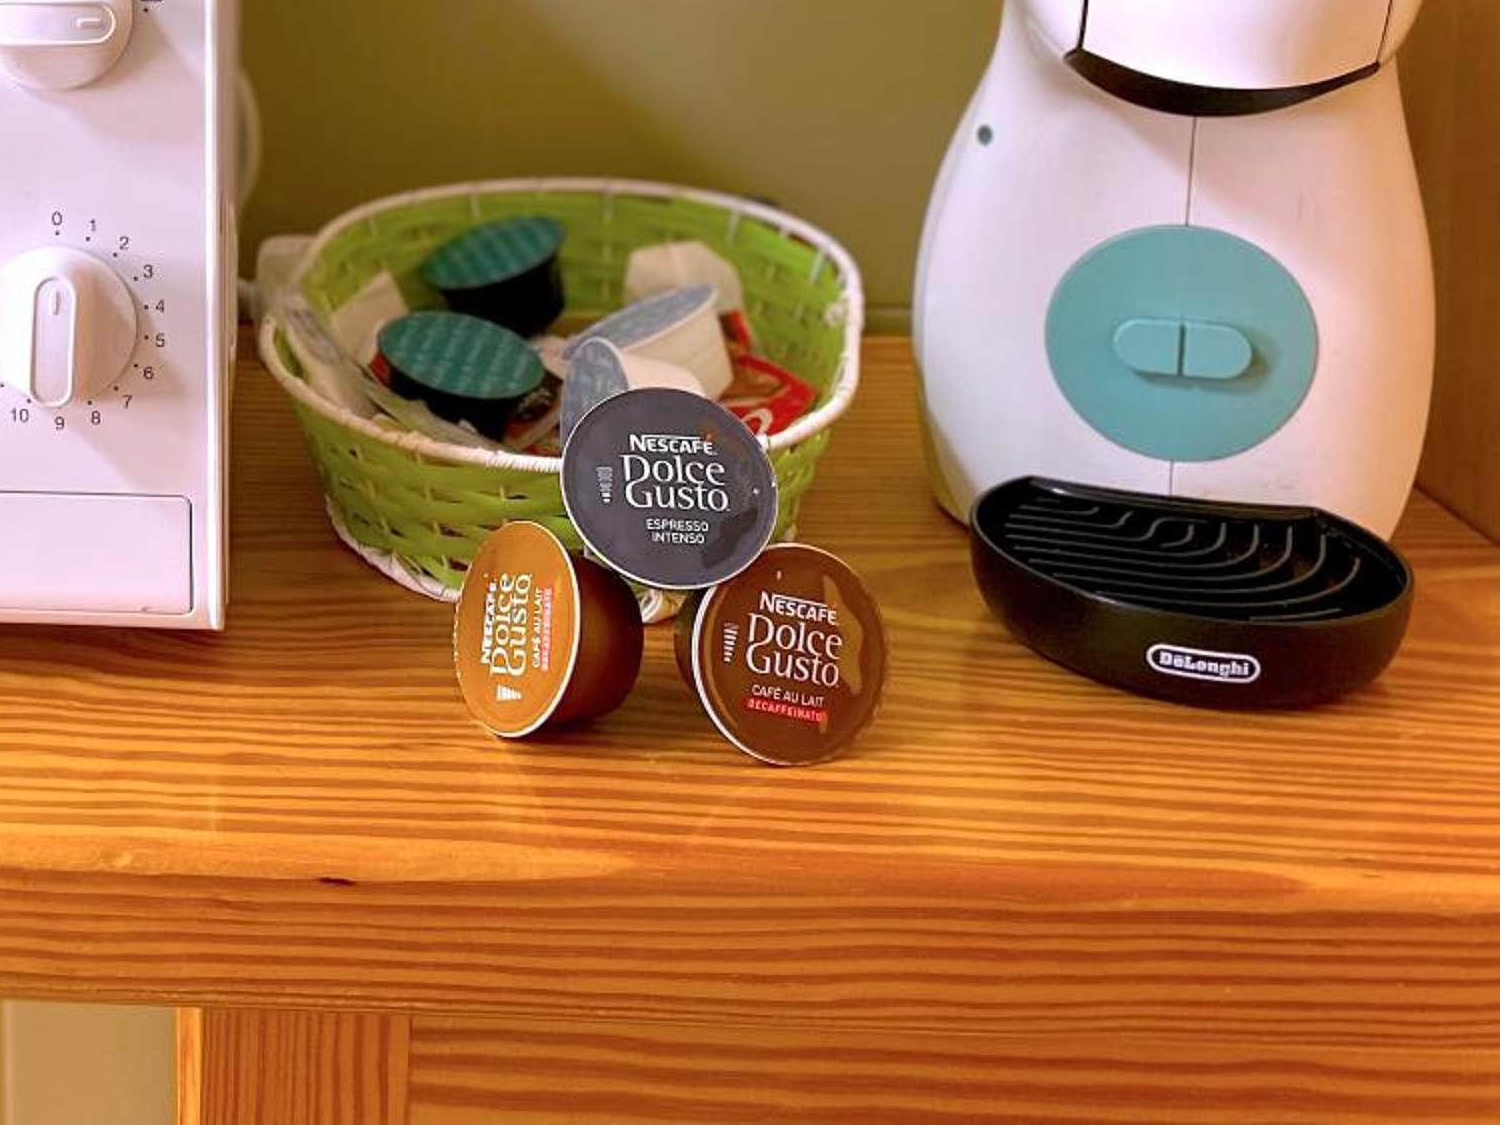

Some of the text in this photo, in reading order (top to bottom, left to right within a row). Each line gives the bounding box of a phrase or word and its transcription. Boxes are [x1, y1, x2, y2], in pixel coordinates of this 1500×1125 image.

[51, 211, 63, 226] 0
[89, 219, 96, 232] 1
[119, 236, 129, 250] 2
[143, 264, 153, 279] 3
[155, 299, 165, 313] 4
[155, 332, 165, 348] 5
[143, 367, 154, 380] 6
[122, 395, 132, 409] 7
[11, 408, 29, 423] 10
[54, 416, 65, 430] 9
[91, 410, 101, 425] 8
[620, 453, 726, 486] Dolce
[625, 480, 729, 512] Gusto
[646, 518, 709, 532] ESPRESSO
[652, 532, 705, 544] INTENSO
[490, 573, 515, 674] Dolce
[507, 575, 531, 676] Gusto
[747, 613, 843, 660] Dolce
[746, 642, 840, 687] Gusto
[1159, 651, 1249, 677] DeLonghi
[751, 684, 824, 707] CAFÉ AU LAIT
